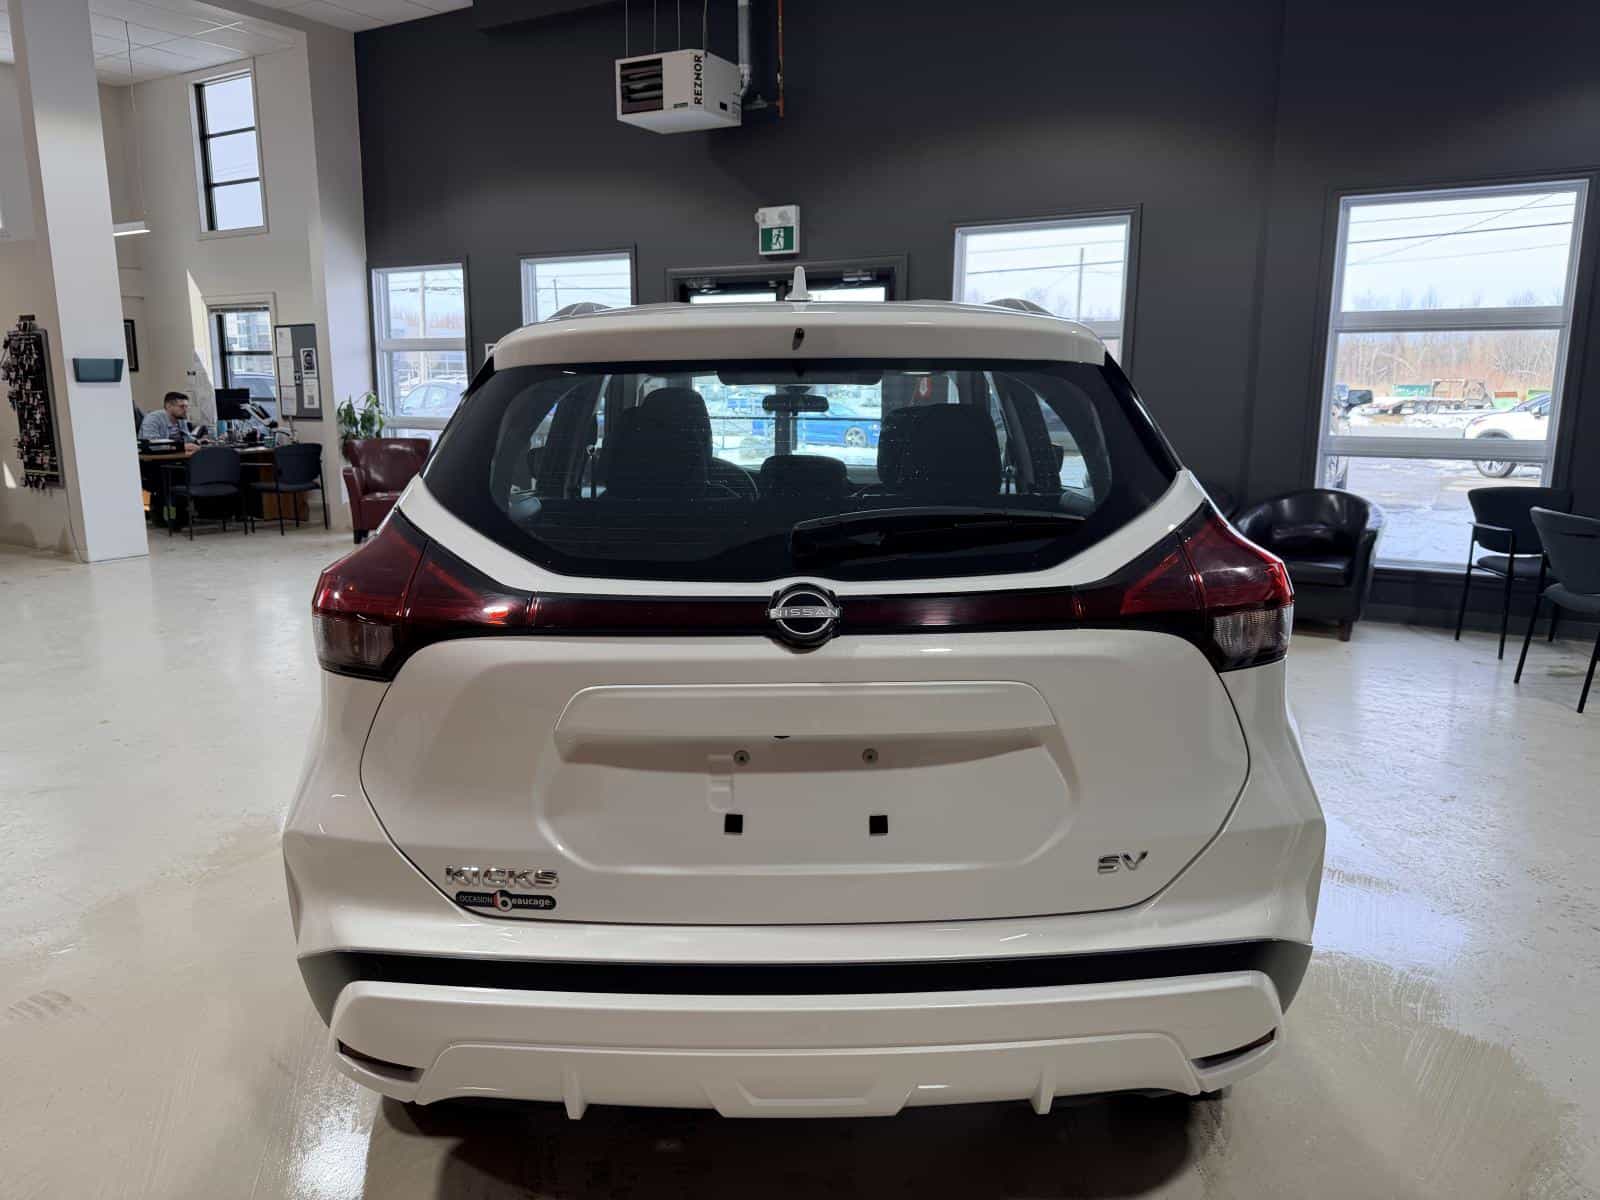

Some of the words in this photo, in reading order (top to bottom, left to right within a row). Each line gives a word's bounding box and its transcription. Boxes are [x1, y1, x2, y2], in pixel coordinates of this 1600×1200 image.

[694, 55, 703, 105] REZNOR
[770, 608, 838, 617] NISSAN
[1097, 851, 1149, 874] SV
[445, 865, 559, 889] KICKS
